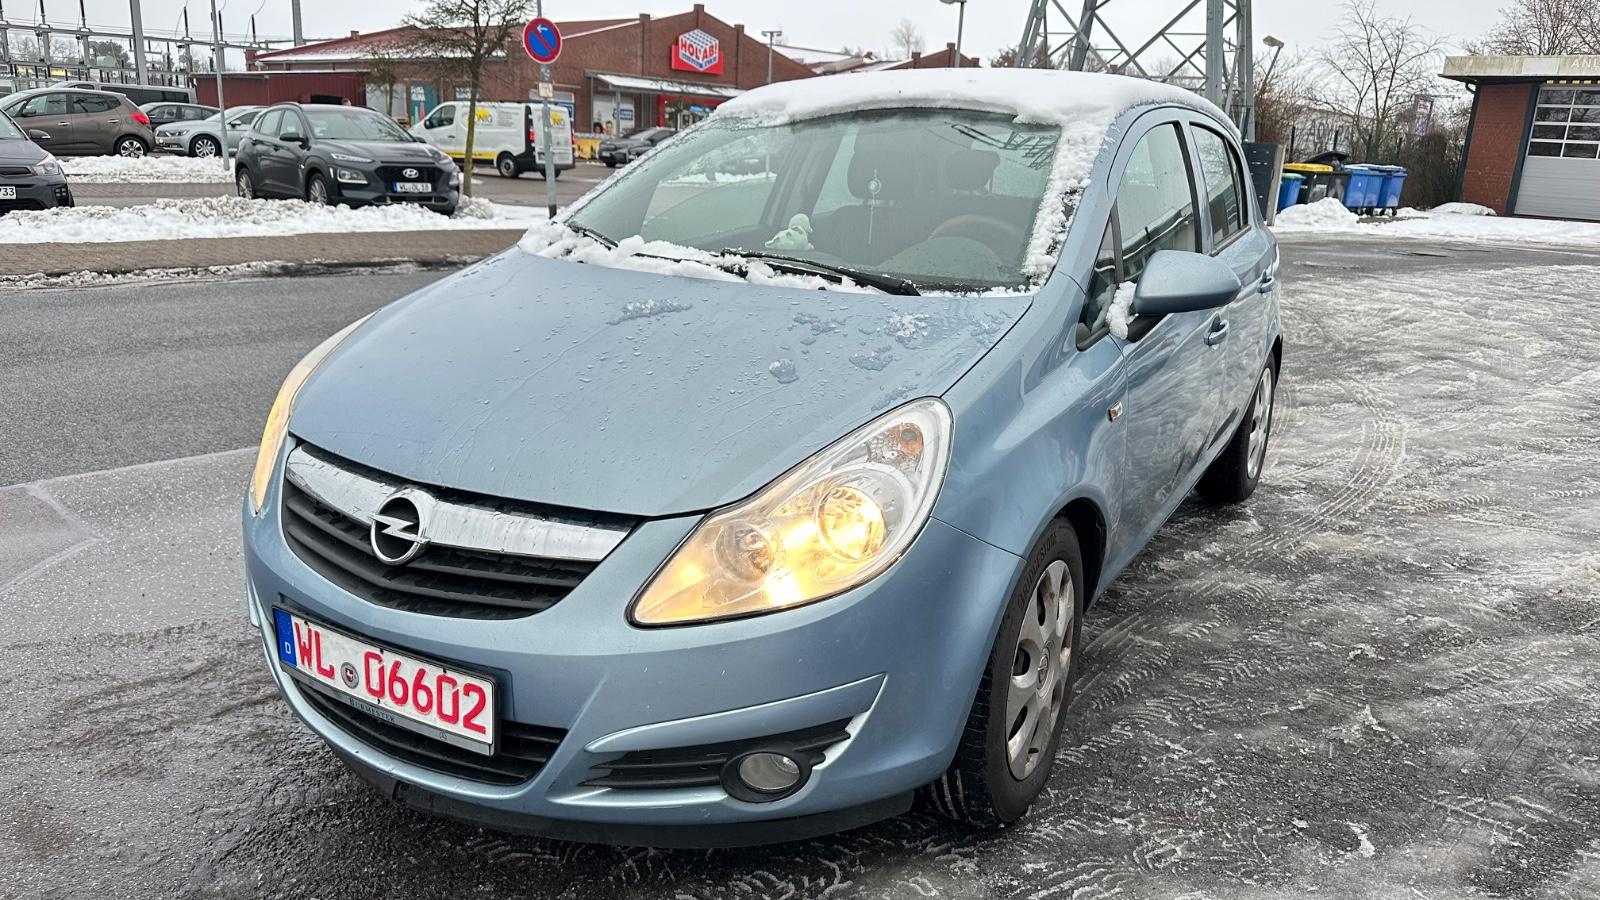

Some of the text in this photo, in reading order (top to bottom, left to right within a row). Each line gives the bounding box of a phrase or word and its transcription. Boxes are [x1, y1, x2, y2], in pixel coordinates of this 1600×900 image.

[0, 187, 15, 197] 33
[284, 641, 291, 655] D
[294, 622, 487, 735] WL 06602
